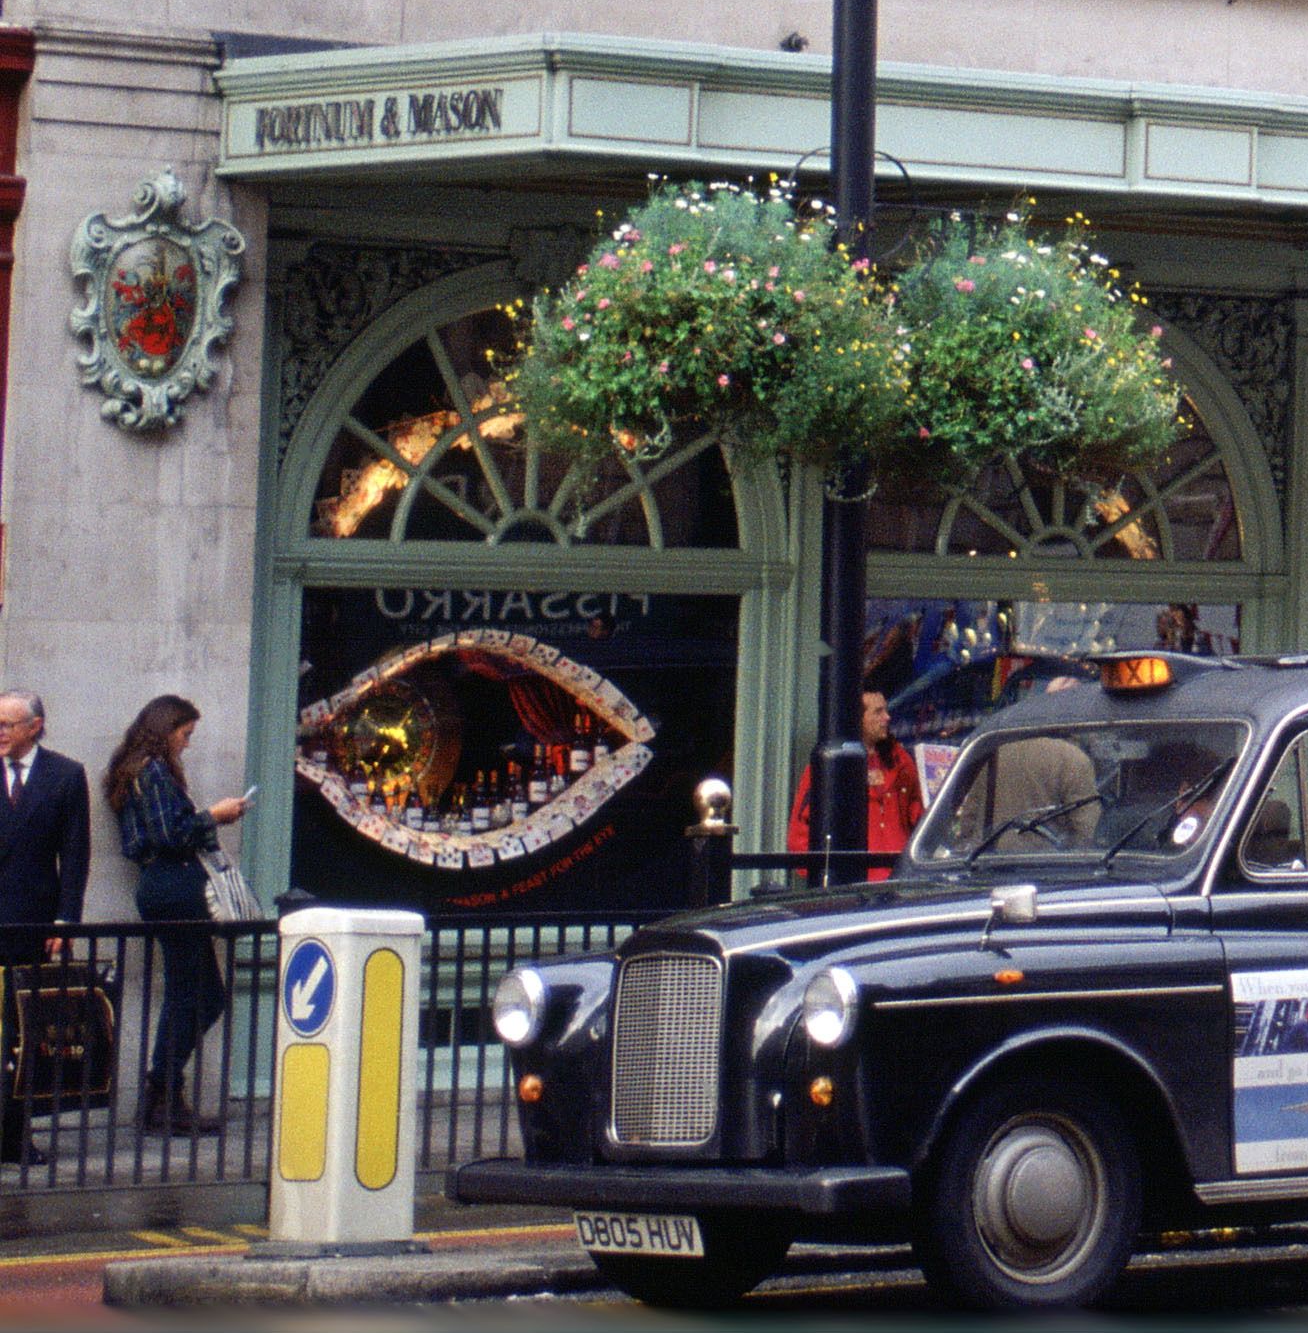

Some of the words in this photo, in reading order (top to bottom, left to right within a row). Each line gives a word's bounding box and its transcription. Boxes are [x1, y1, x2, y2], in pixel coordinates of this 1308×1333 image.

[380, 97, 400, 138] &
[406, 88, 504, 137] MASON
[577, 1215, 643, 1249] D805
[646, 1218, 696, 1252] HUV
